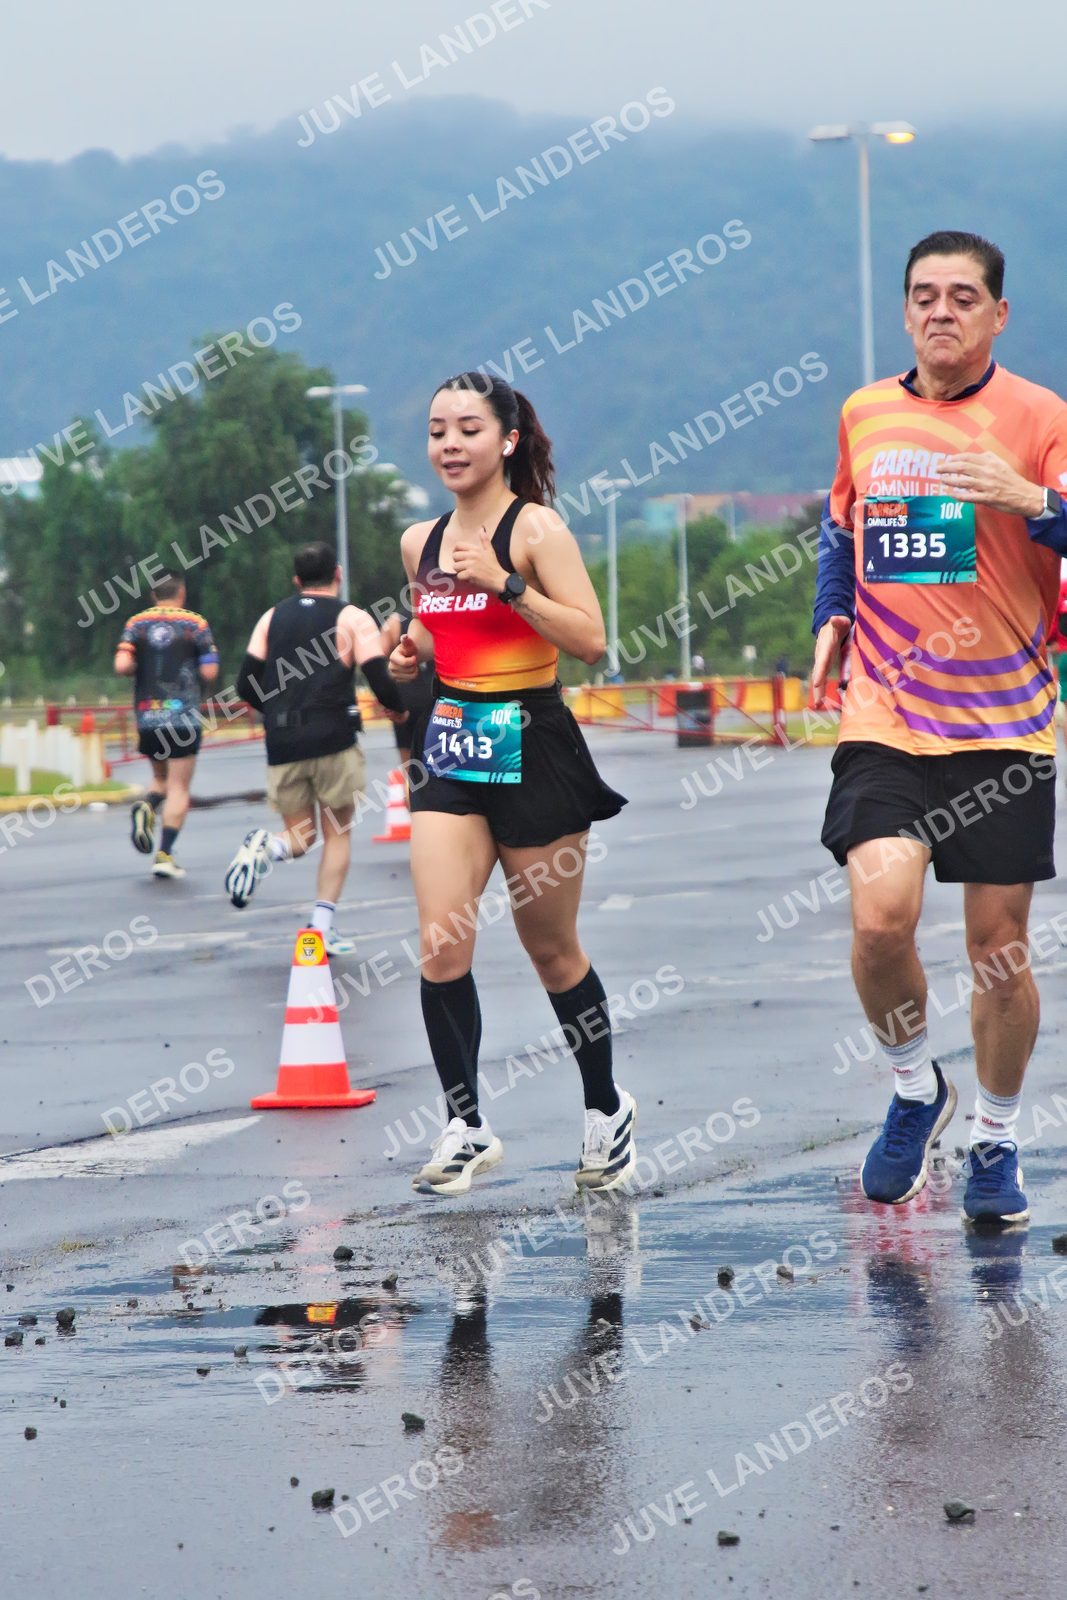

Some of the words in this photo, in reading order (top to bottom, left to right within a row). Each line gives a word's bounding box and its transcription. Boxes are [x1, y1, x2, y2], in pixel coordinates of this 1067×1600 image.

[870, 448, 953, 480] CARRE
[940, 502, 963, 519] 10K
[879, 532, 946, 558] 1335
[454, 593, 488, 611] LAB
[490, 709, 512, 725] 10K
[438, 731, 493, 759] 1413
